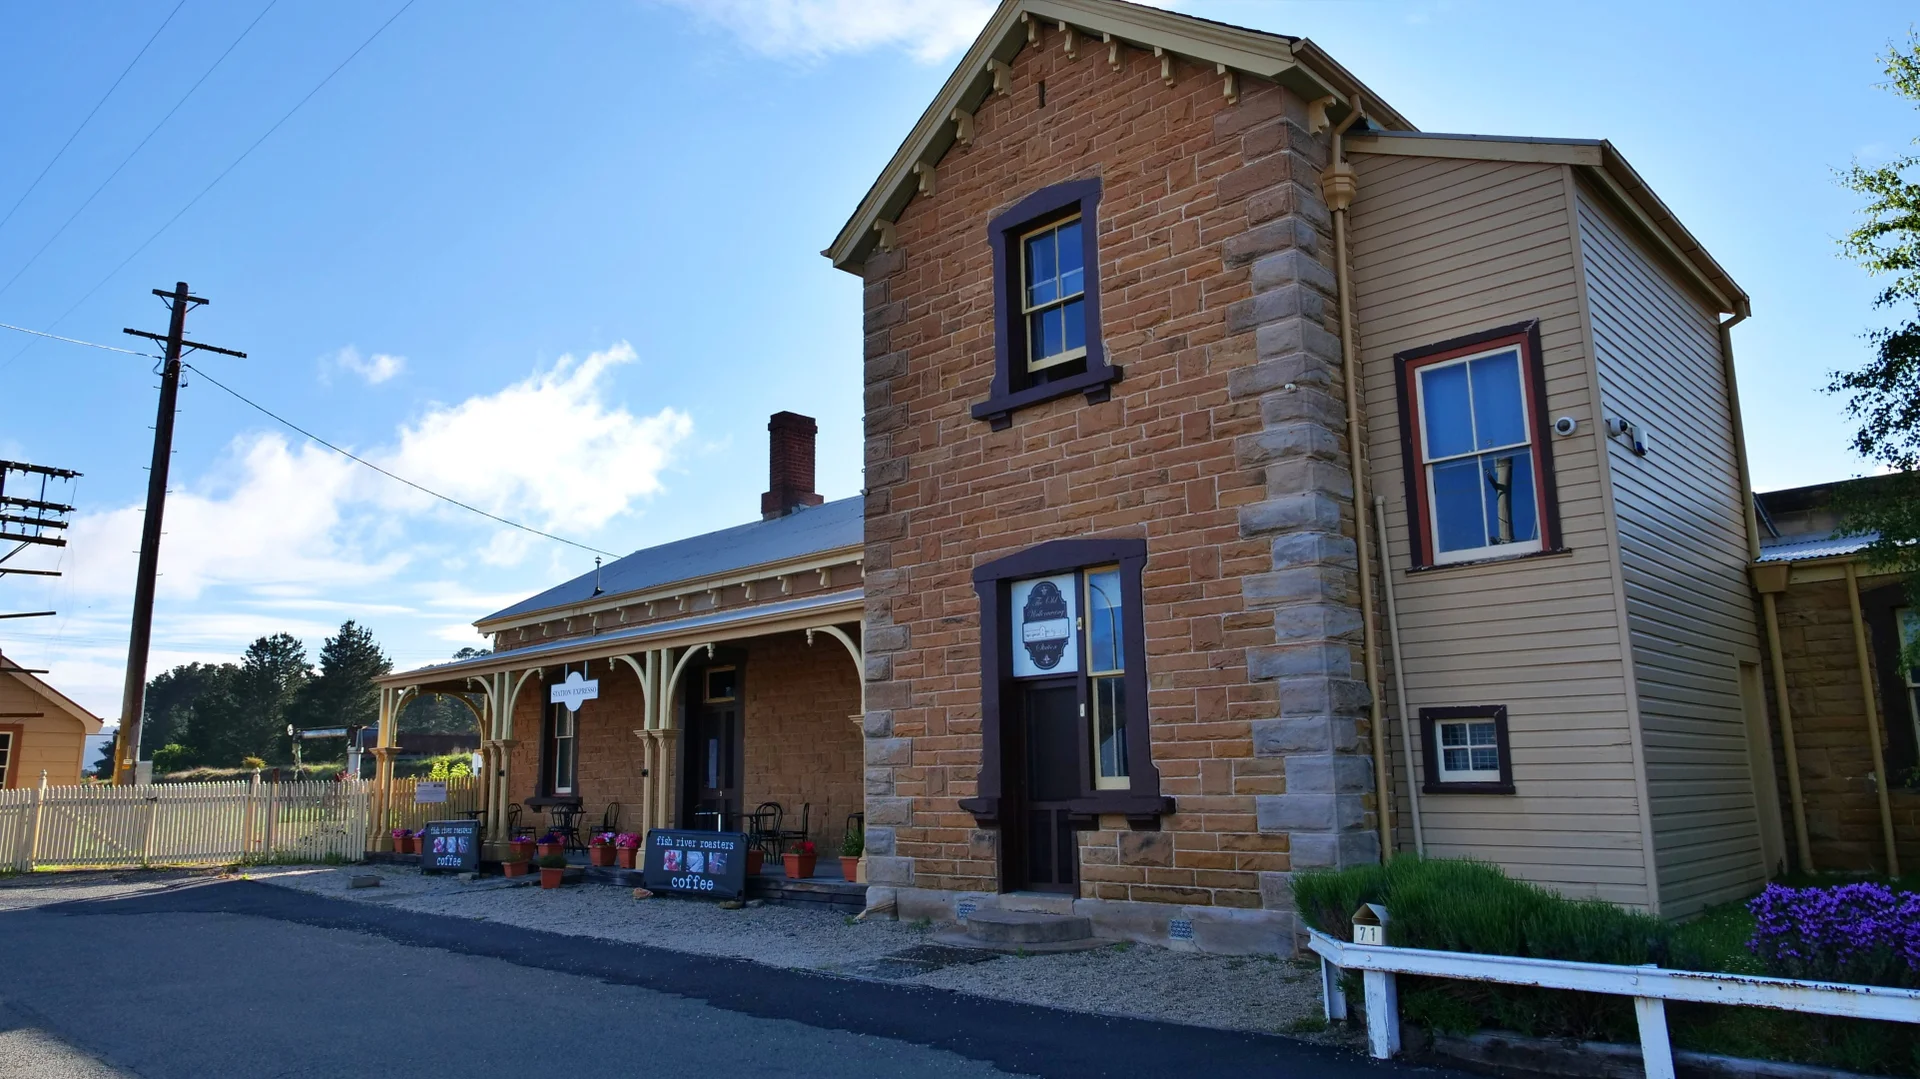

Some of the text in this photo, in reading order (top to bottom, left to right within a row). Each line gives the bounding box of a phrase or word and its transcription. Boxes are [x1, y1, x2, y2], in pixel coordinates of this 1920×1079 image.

[553, 686, 597, 697] STATION EXPRESSO
[430, 827, 473, 835] fish river roasters
[656, 836, 734, 850] fish river roasters
[436, 855, 462, 867] coffee
[671, 875, 714, 891] coffee
[1360, 926, 1375, 942] 71
